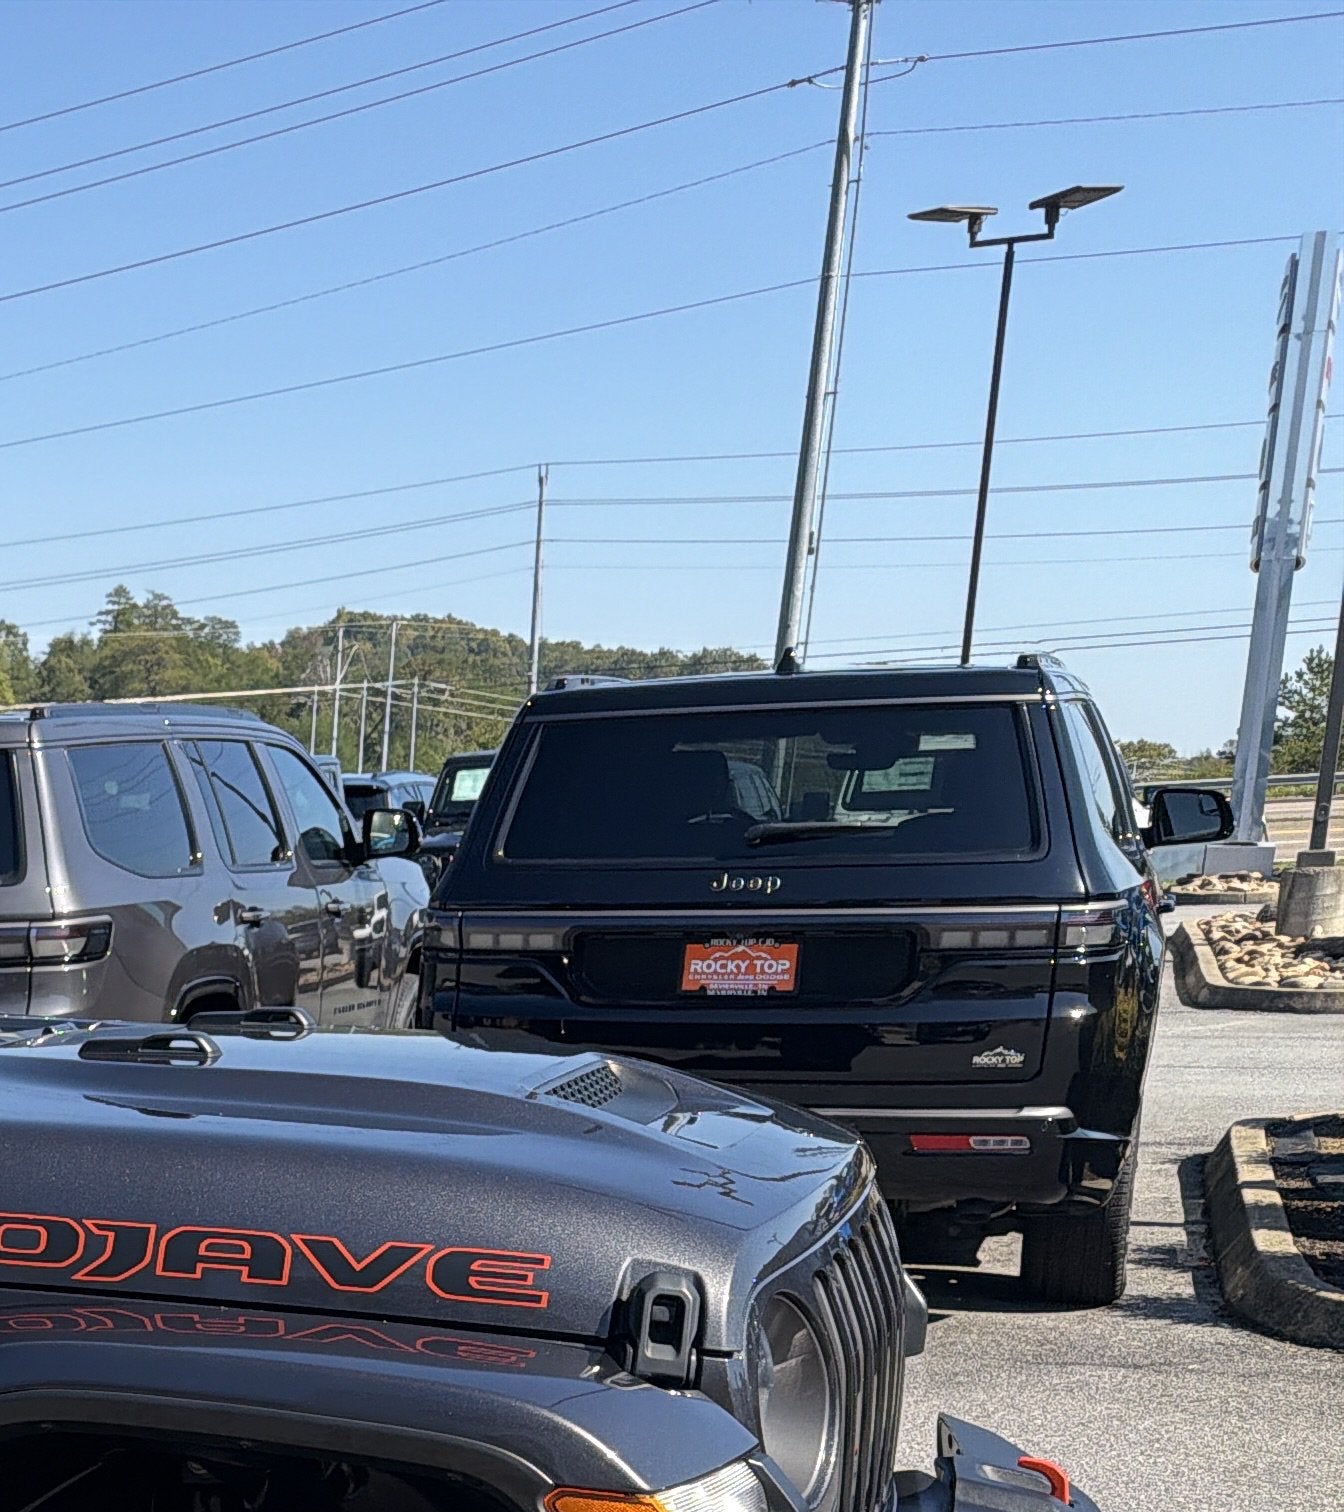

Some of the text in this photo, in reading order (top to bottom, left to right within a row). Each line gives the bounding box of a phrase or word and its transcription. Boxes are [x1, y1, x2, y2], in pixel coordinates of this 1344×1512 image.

[689, 959, 791, 974] ROCKY TOP
[972, 1055, 1004, 1064] ROCKY
